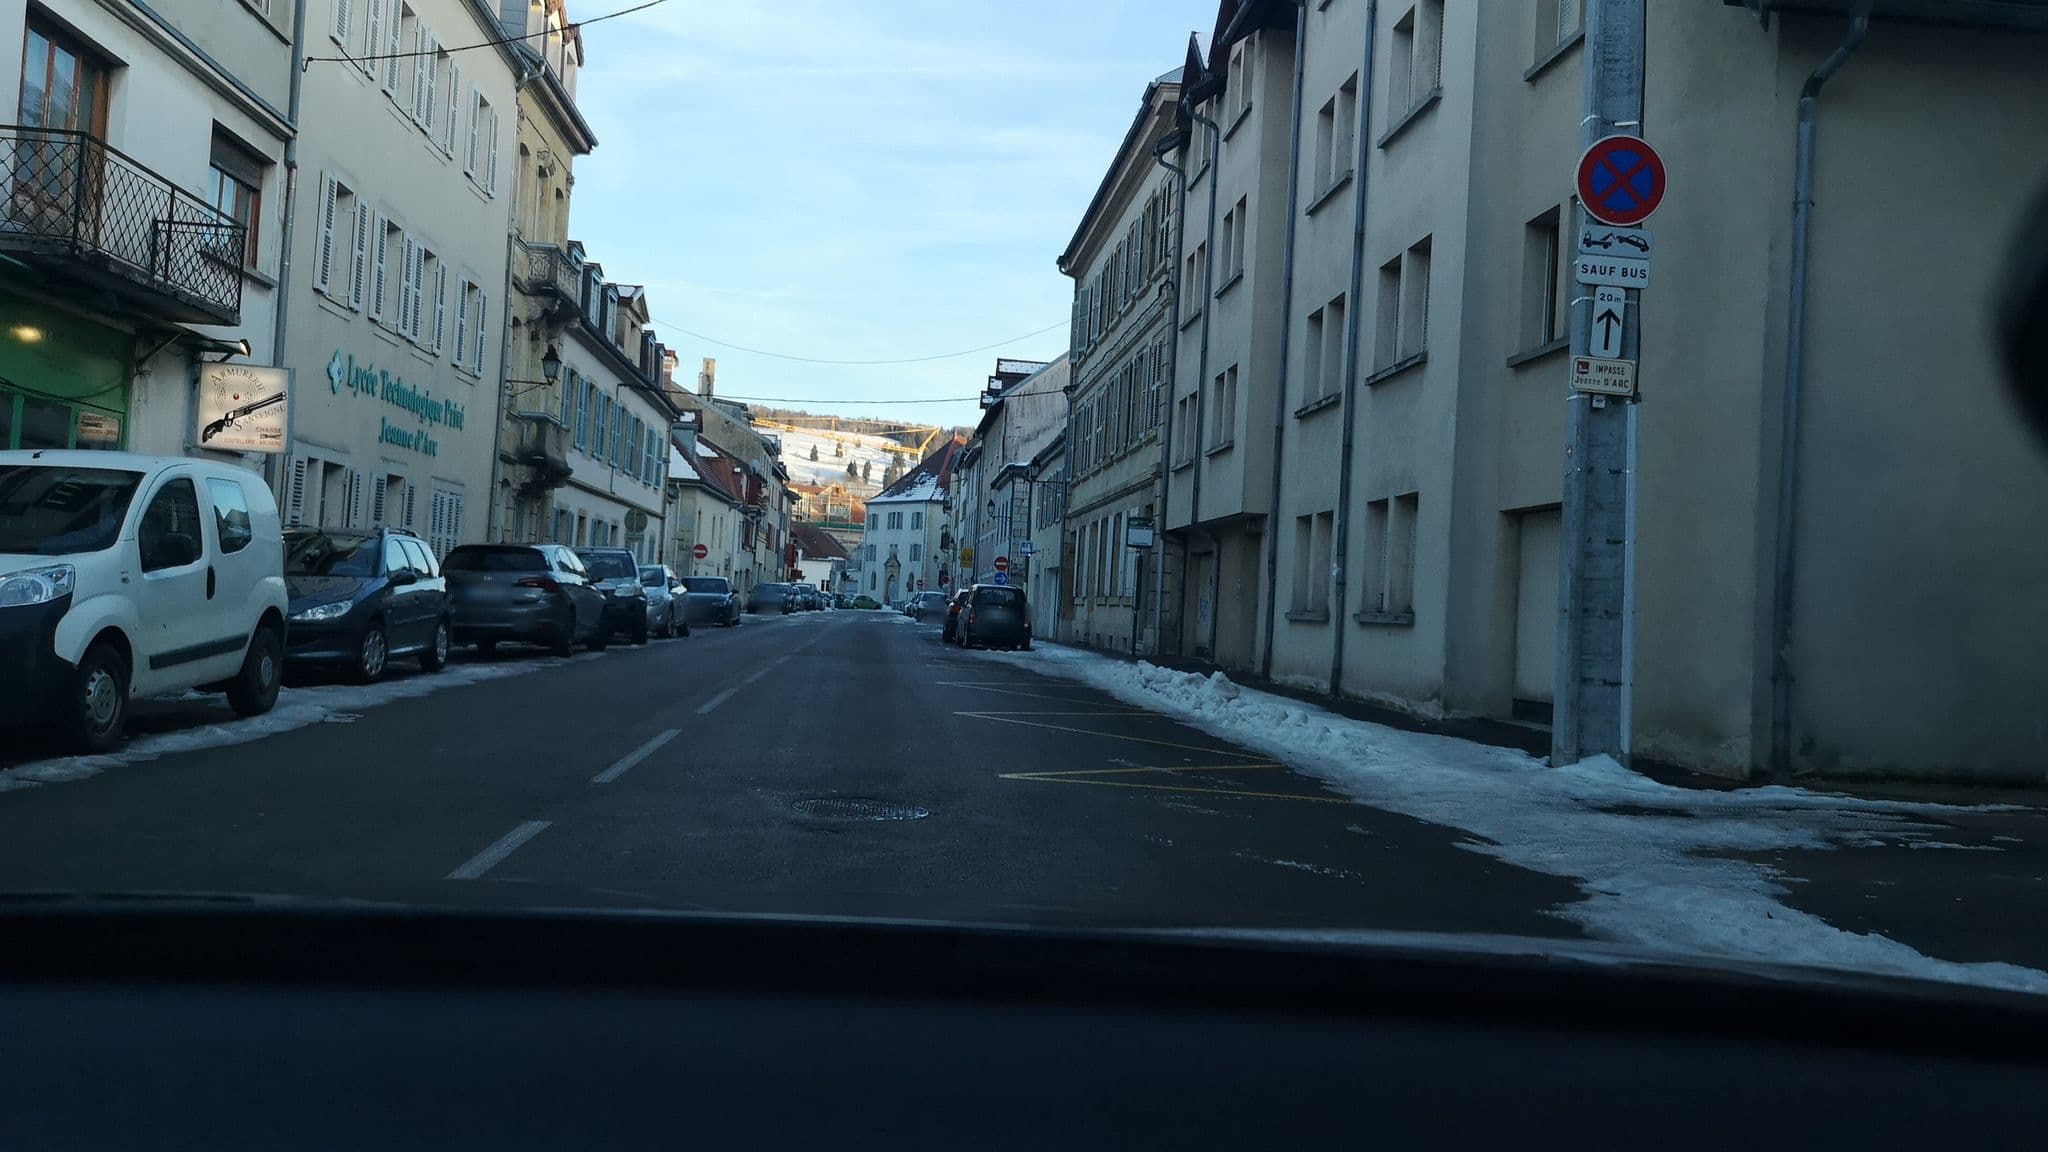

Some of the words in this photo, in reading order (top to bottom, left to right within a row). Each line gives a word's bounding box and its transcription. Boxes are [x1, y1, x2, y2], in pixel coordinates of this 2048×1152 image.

[1581, 264, 1616, 276] SAUF
[1621, 267, 1647, 279] BUS
[211, 367, 265, 392] ARMURERIE
[1596, 365, 1625, 376] IMPASSE
[347, 353, 378, 398] Lycée
[379, 368, 443, 427] Technologique
[444, 398, 465, 431] Privé
[1604, 379, 1630, 389] D'ARC
[378, 416, 414, 449] Jeanne
